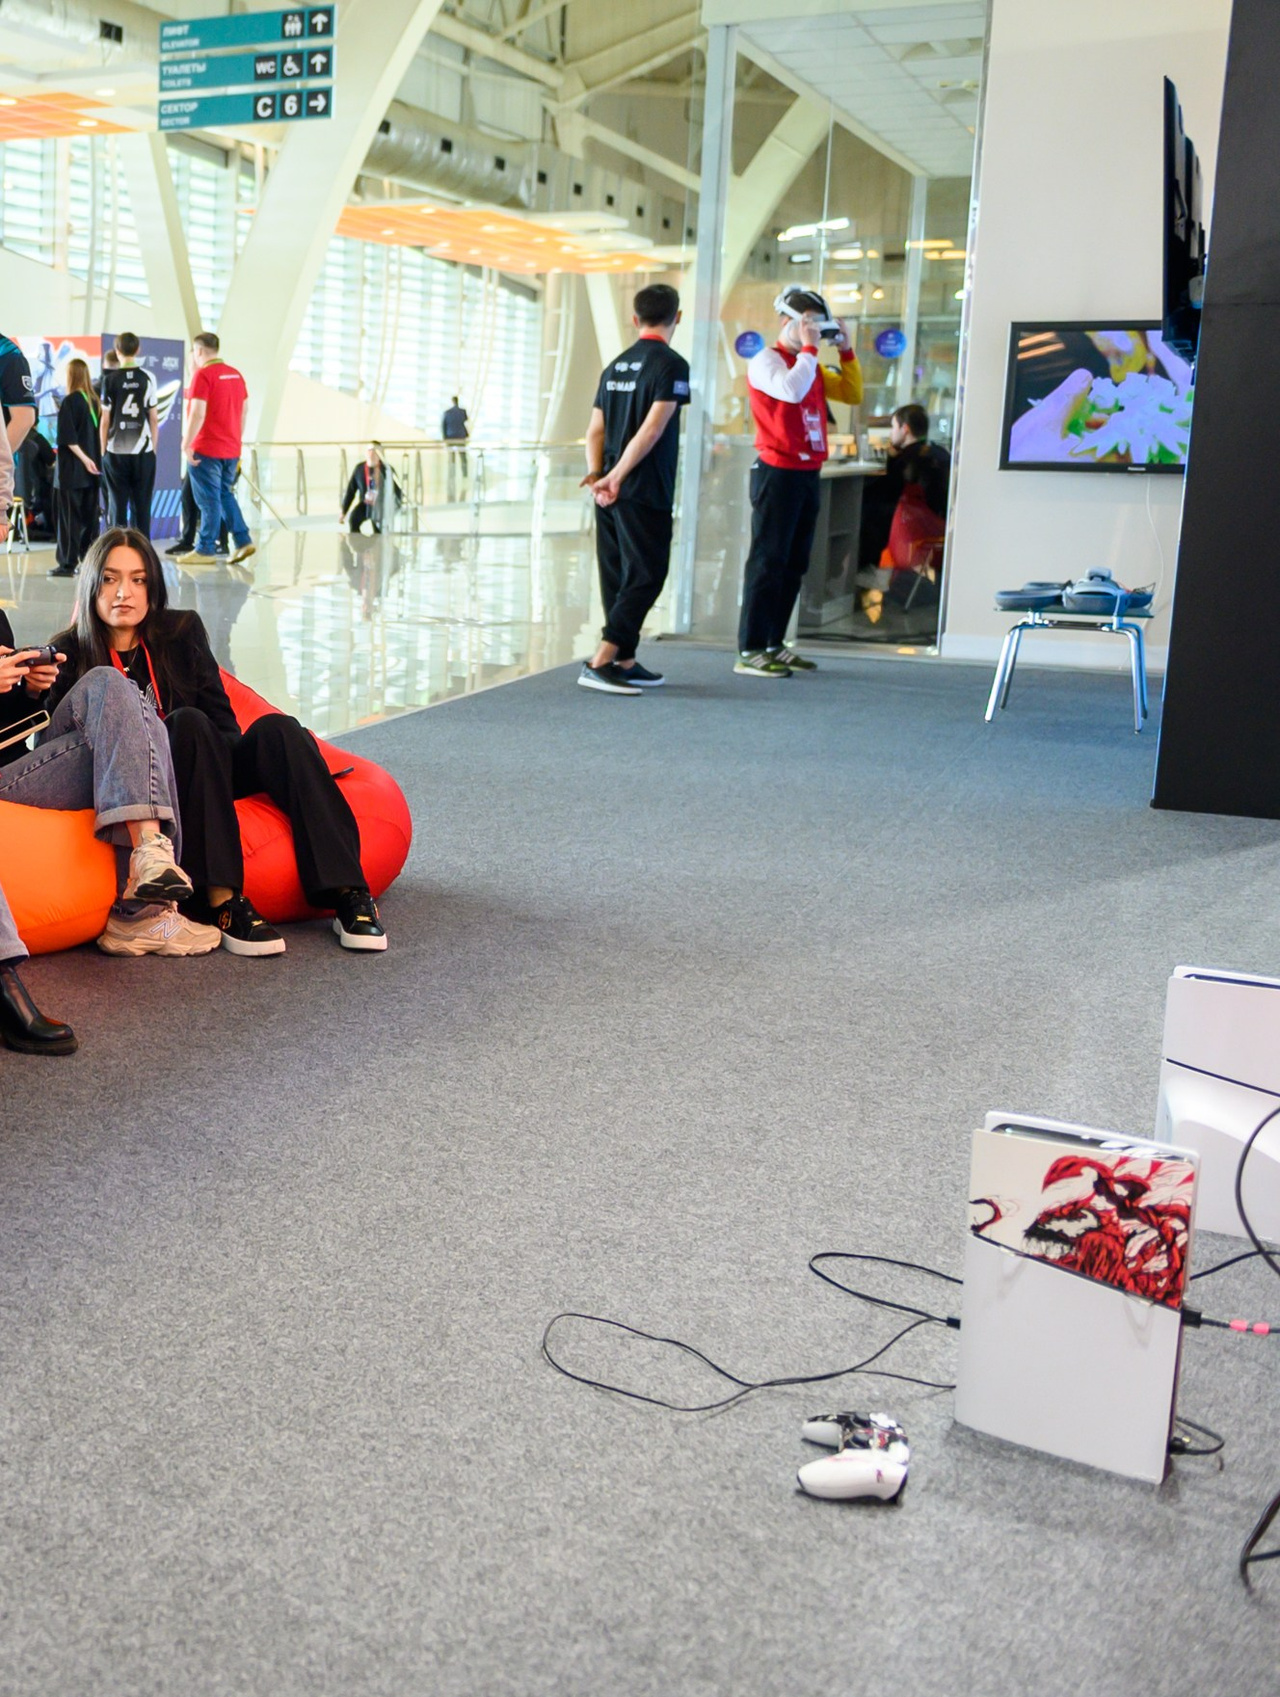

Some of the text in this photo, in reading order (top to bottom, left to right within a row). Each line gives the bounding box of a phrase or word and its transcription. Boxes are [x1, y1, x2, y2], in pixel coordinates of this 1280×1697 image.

[162, 63, 206, 75] ТУАЛЕТЫ
[256, 61, 275, 74] WC
[161, 102, 197, 115] СЕКТОР
[284, 95, 297, 115] 6
[122, 393, 140, 418] 4
